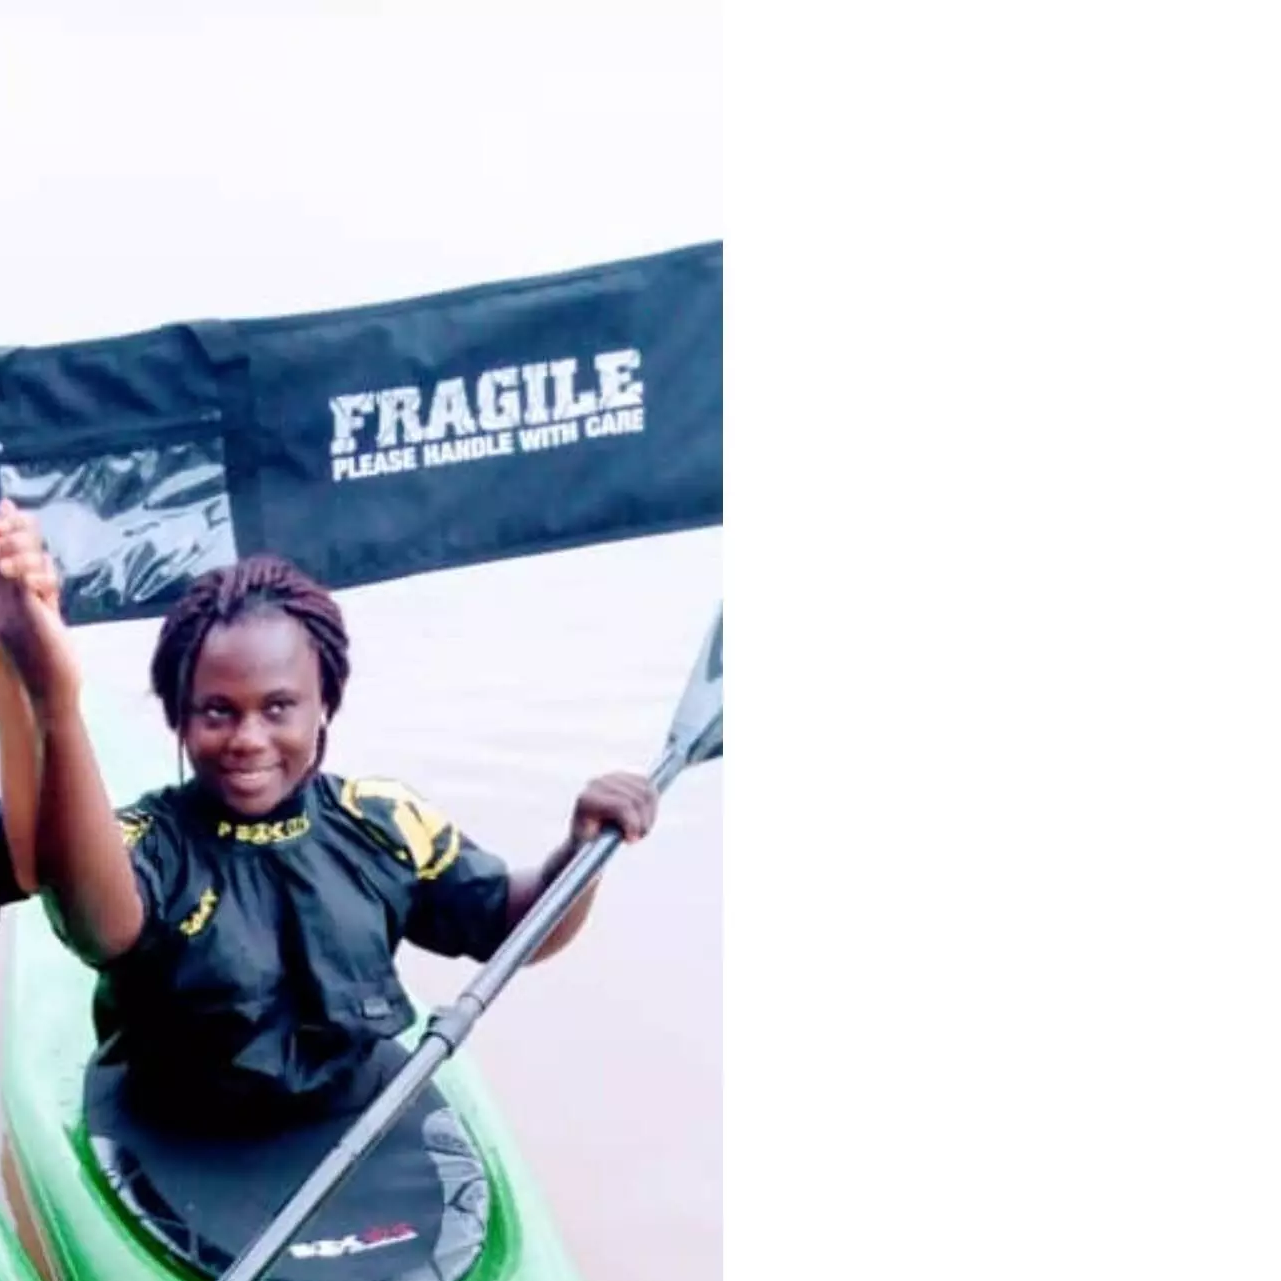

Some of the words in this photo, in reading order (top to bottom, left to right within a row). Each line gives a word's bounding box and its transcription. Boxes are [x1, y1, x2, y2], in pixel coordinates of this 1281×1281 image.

[328, 348, 644, 456] FRAGILE
[330, 446, 417, 482] PLEASE
[422, 431, 515, 468] HANDLE
[520, 421, 580, 453] WITH
[583, 405, 645, 440] CARE
